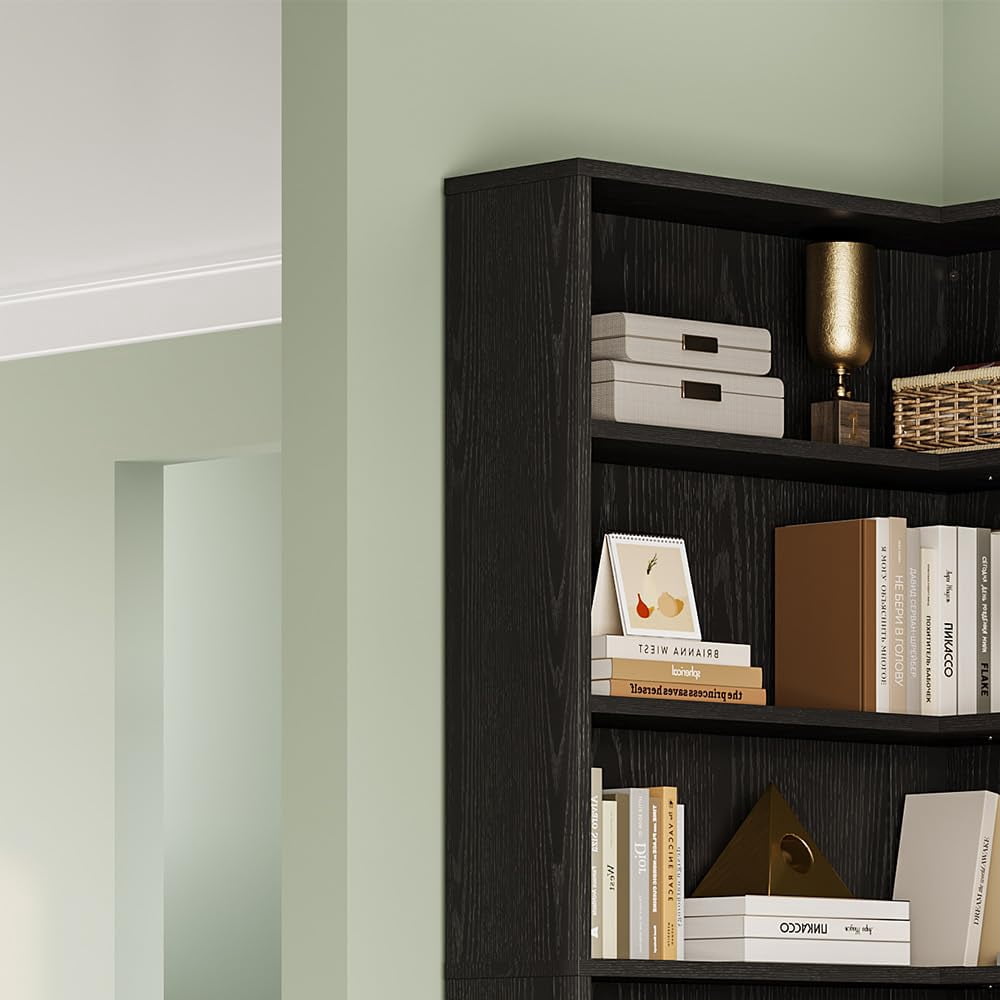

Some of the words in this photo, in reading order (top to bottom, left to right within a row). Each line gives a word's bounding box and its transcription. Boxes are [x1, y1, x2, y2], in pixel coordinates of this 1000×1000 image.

[895, 575, 903, 590] НЕ
[894, 593, 903, 624] БЕРИ
[894, 640, 903, 686] ГОЛОВУ
[944, 623, 953, 678] ПИКАССО
[973, 893, 982, 925] DREAM
[981, 836, 989, 866] AWAKE
[780, 923, 827, 934] ПИКАССО
